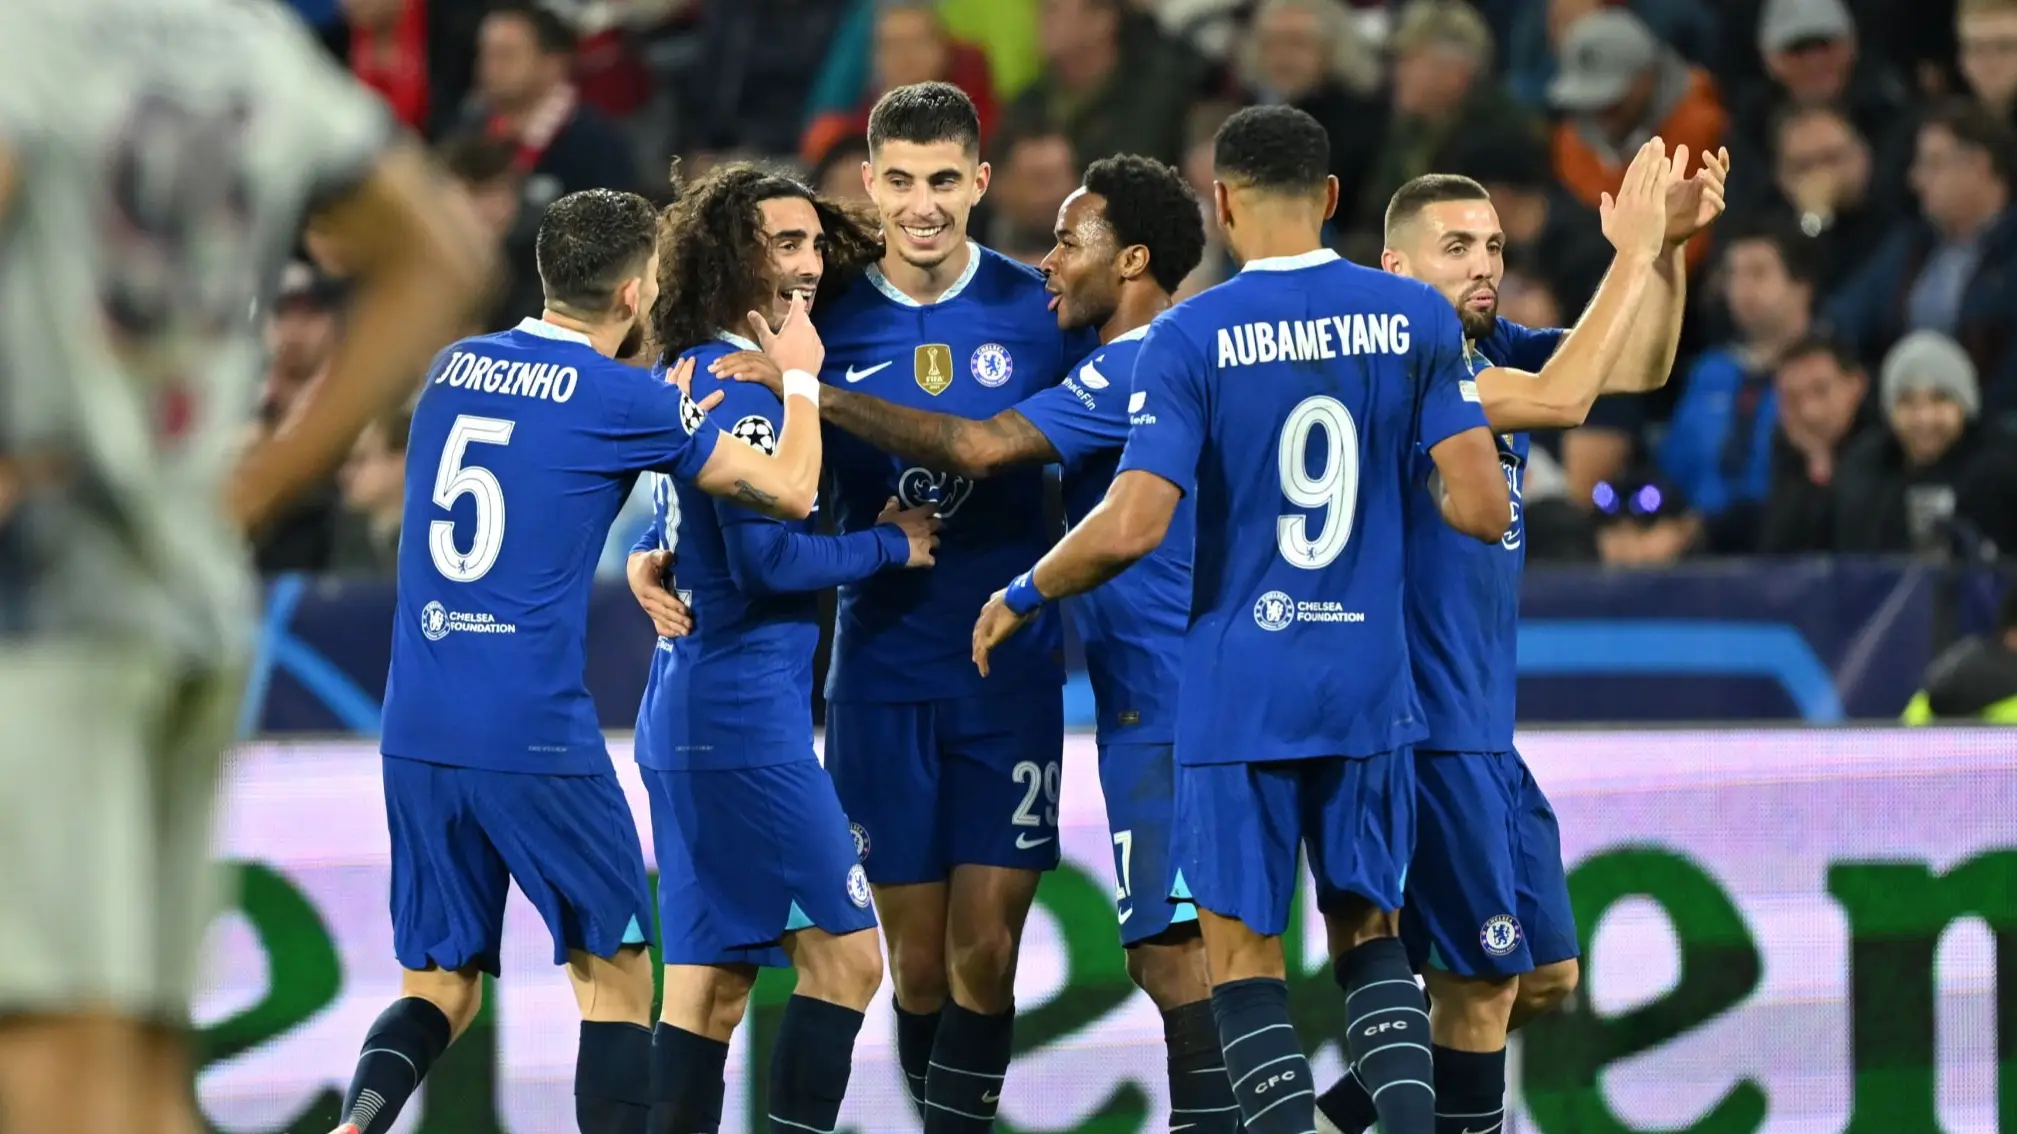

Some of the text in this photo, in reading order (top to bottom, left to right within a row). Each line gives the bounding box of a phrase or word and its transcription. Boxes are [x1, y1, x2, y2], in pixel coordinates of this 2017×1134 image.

[1217, 313, 1410, 368] AUBAMEYANG
[436, 352, 578, 403] JORGINHO
[1277, 395, 1359, 569] 9
[429, 414, 515, 582] 5
[449, 611, 495, 623] CHELSEA
[1297, 601, 1343, 611] CHELSEA
[1297, 612, 1365, 622] FOUNDATION
[450, 622, 516, 633] FOUNDATION
[1012, 760, 1060, 827] 29
[1364, 1020, 1408, 1036] CFC
[1254, 1070, 1296, 1094] CFC
